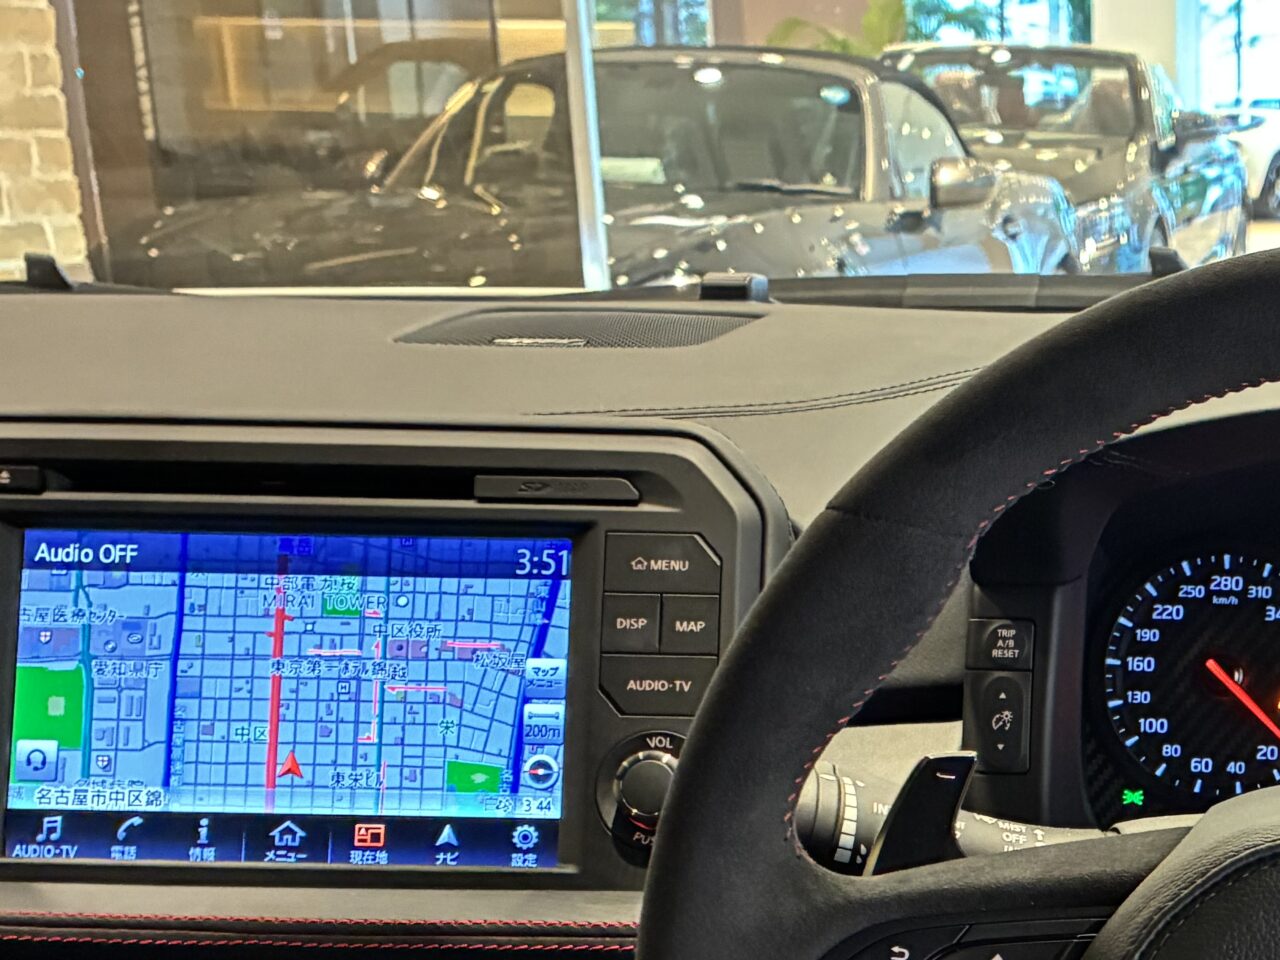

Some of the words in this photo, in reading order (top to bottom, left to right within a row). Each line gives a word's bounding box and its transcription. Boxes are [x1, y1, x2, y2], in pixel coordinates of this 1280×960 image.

[34, 542, 93, 562] Audio
[99, 544, 138, 563] OFF
[515, 548, 568, 575] 3:51
[650, 559, 689, 571] MENU
[1210, 576, 1243, 591] 280
[1178, 585, 1205, 598] 250
[1247, 585, 1272, 599] 310
[324, 594, 388, 610] TOWER
[1212, 596, 1239, 606] km/h
[1152, 604, 1184, 620] 220
[616, 618, 647, 629] DISP
[675, 621, 705, 632] MAP
[997, 629, 1017, 638] TRIP
[1135, 629, 1160, 642] 190
[996, 639, 1015, 648] A/B
[992, 649, 1020, 659] RESET
[1126, 656, 1155, 672] 160
[531, 666, 559, 677] マップ
[526, 679, 563, 689] メニュー
[1126, 691, 1151, 704] 130
[438, 719, 456, 735] 栄
[525, 723, 561, 738] 200m
[1138, 718, 1168, 734] 100
[235, 726, 268, 743] 中区
[646, 736, 673, 749] VOL
[1162, 744, 1181, 757] 80
[1256, 745, 1279, 760] 20
[1190, 758, 1213, 773] 60
[1226, 761, 1246, 775] 40
[36, 788, 163, 808] 名古屋市中区錦
[873, 803, 891, 815] IN
[633, 831, 655, 845] PU
[1002, 832, 1027, 844] OFF
[264, 850, 307, 862] メニュー
[350, 850, 388, 865] 現在地
[435, 852, 459, 866] ナビ
[511, 853, 538, 868] 設定
